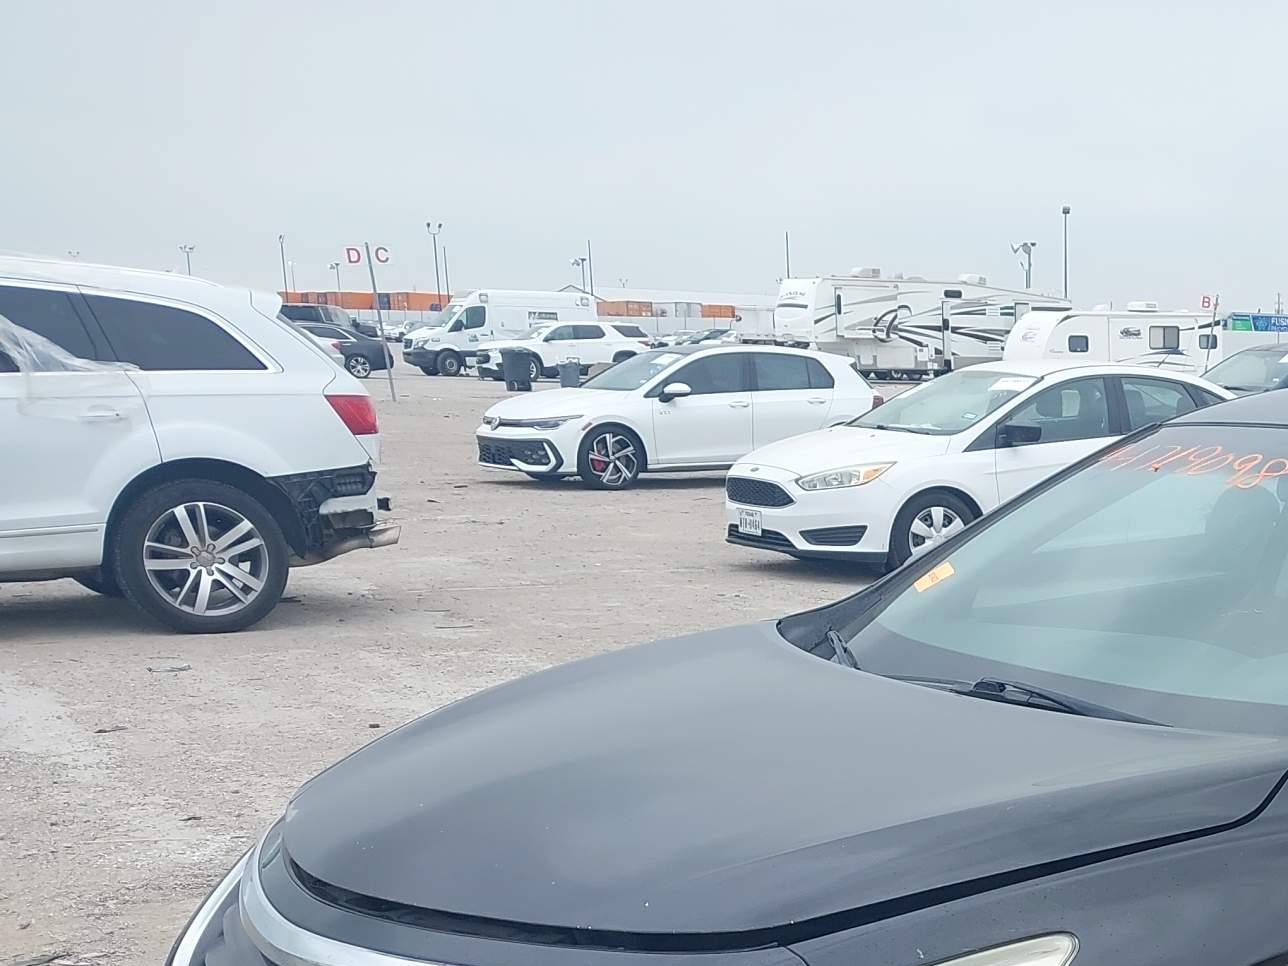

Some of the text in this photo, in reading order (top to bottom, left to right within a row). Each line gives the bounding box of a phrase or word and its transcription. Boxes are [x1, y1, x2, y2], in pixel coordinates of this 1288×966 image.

[345, 247, 361, 263] D
[375, 246, 389, 263] C
[1201, 296, 1211, 308] B
